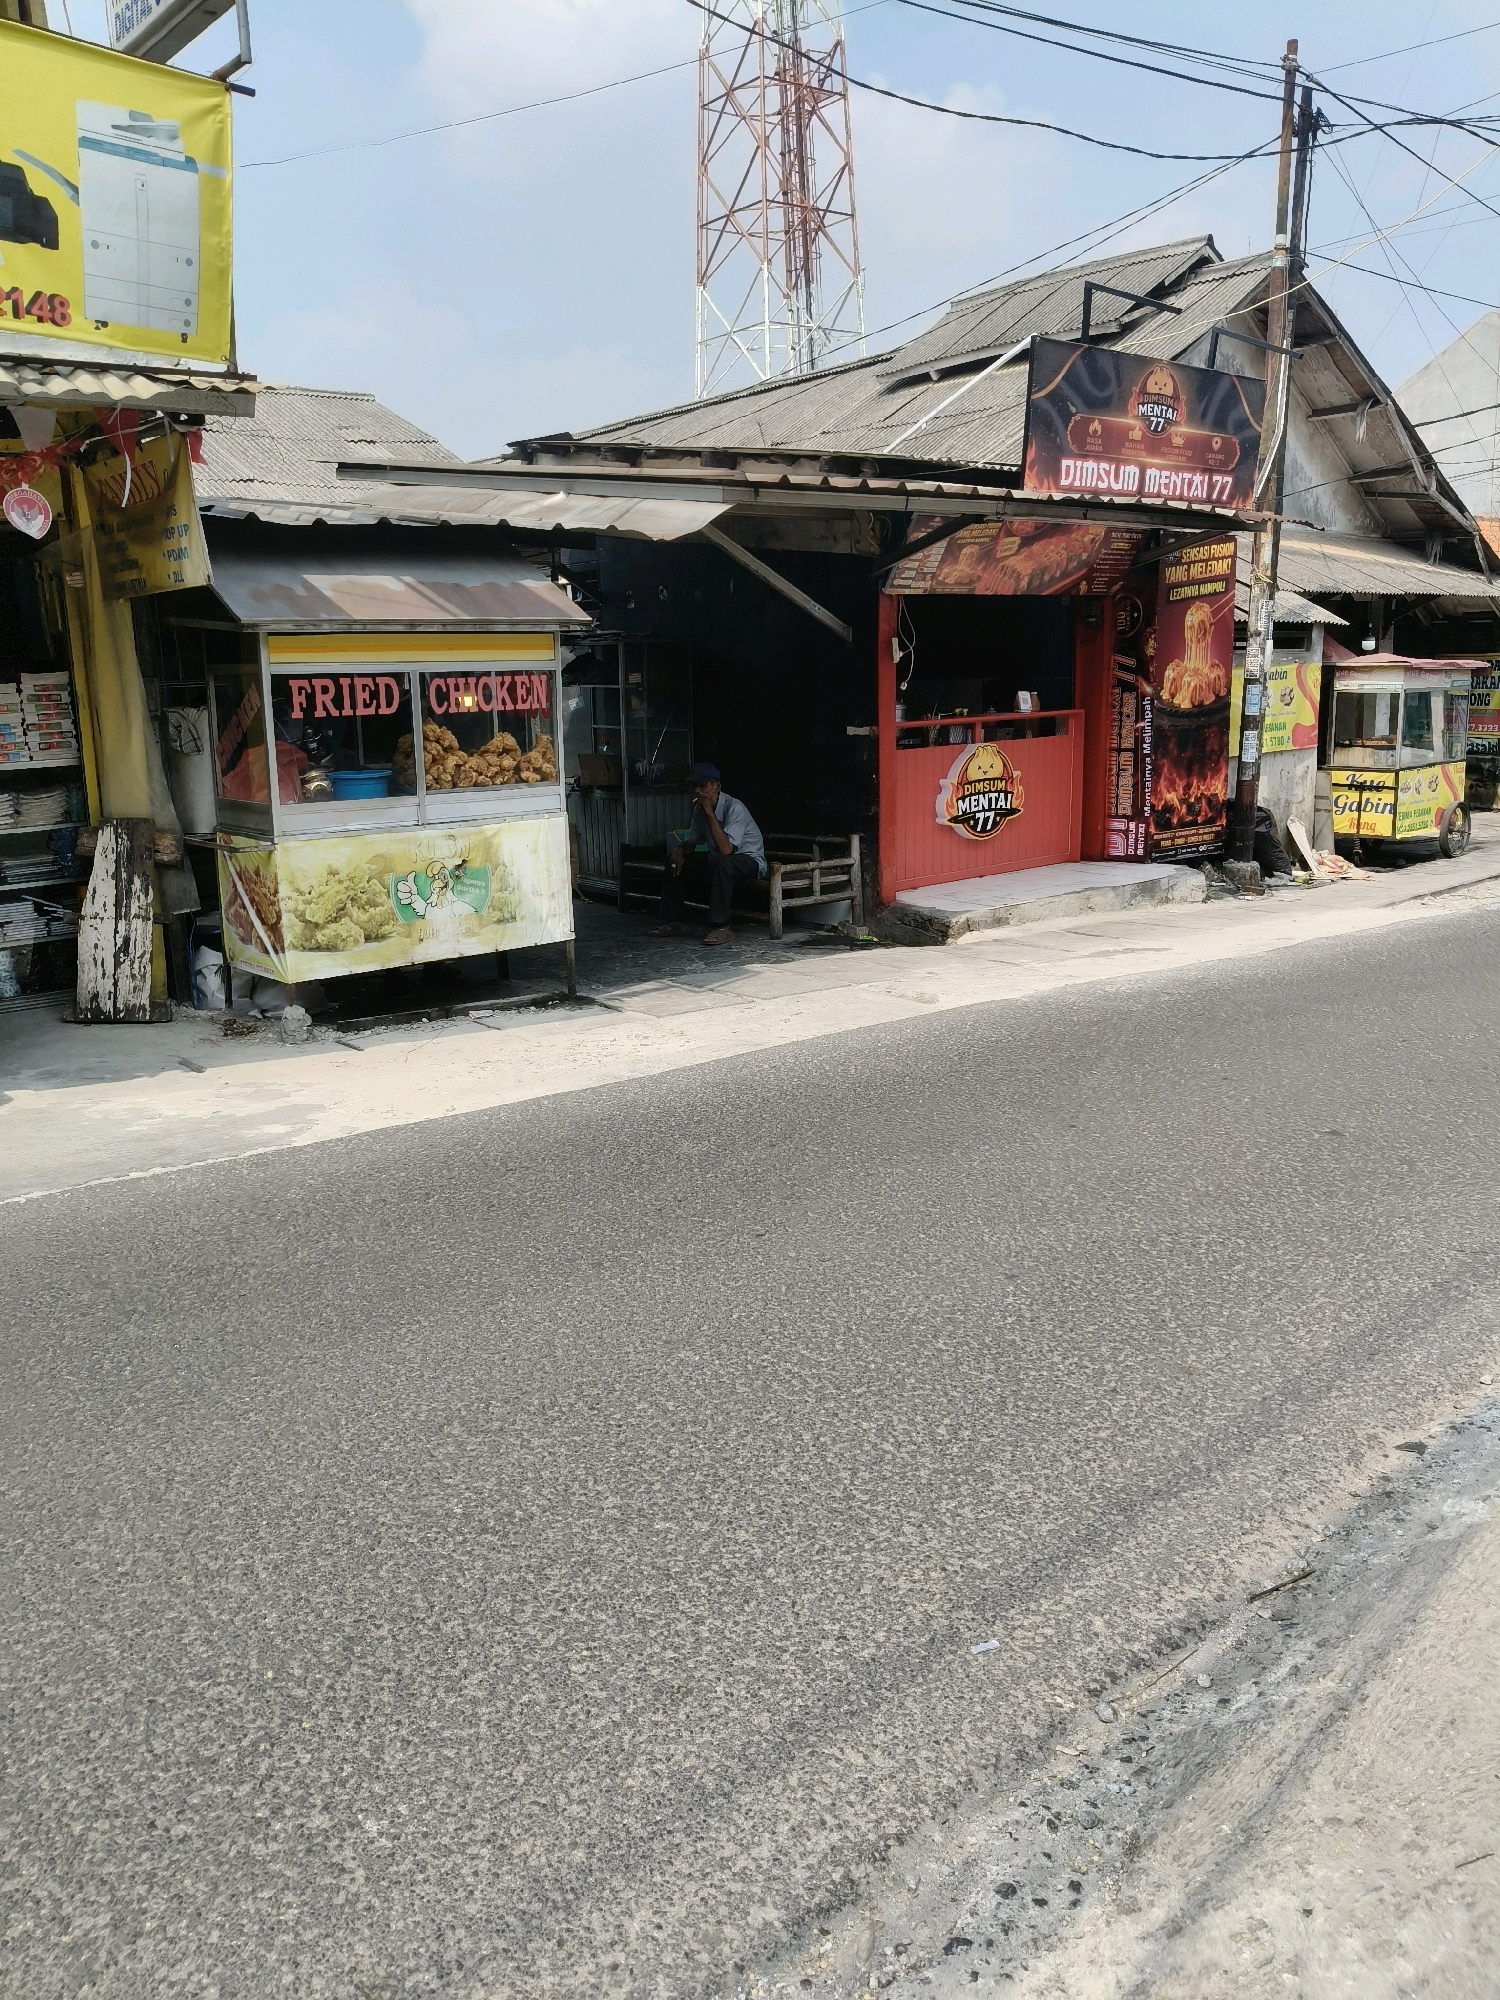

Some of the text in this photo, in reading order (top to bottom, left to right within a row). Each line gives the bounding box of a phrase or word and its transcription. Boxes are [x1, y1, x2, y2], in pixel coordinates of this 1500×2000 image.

[115, 0, 153, 43] DIGITAL
[1144, 394, 1174, 406] DIMSUM
[1138, 403, 1178, 421] MENTAI
[1150, 416, 1165, 431] 77
[1086, 437, 1102, 445] RASA
[1124, 441, 1145, 450] BAHAN
[1121, 447, 1147, 457] PREMIUM
[1060, 459, 1232, 501] DIMSUM MENTAI 77
[177, 523, 190, 538] UP
[1182, 542, 1235, 562] SENSASI FUSION
[1165, 558, 1232, 583] YANG MELEDAK!
[1169, 580, 1226, 600] LEZATNYA NAMPOL!
[288, 674, 548, 719] FRIED CHICKEN
[216, 682, 261, 770] CHICKEN
[1143, 696, 1152, 754] Melimpah
[1117, 691, 1137, 815] DIMSUM BAKAR
[964, 779, 1006, 795] DIMSUM
[1345, 773, 1386, 793] Kue
[957, 792, 1013, 816] MENTAI
[1333, 793, 1394, 816] Gabin
[975, 811, 995, 832] 77
[1127, 821, 1136, 855] DIMSUM
[1136, 823, 1146, 856] MENTAI
